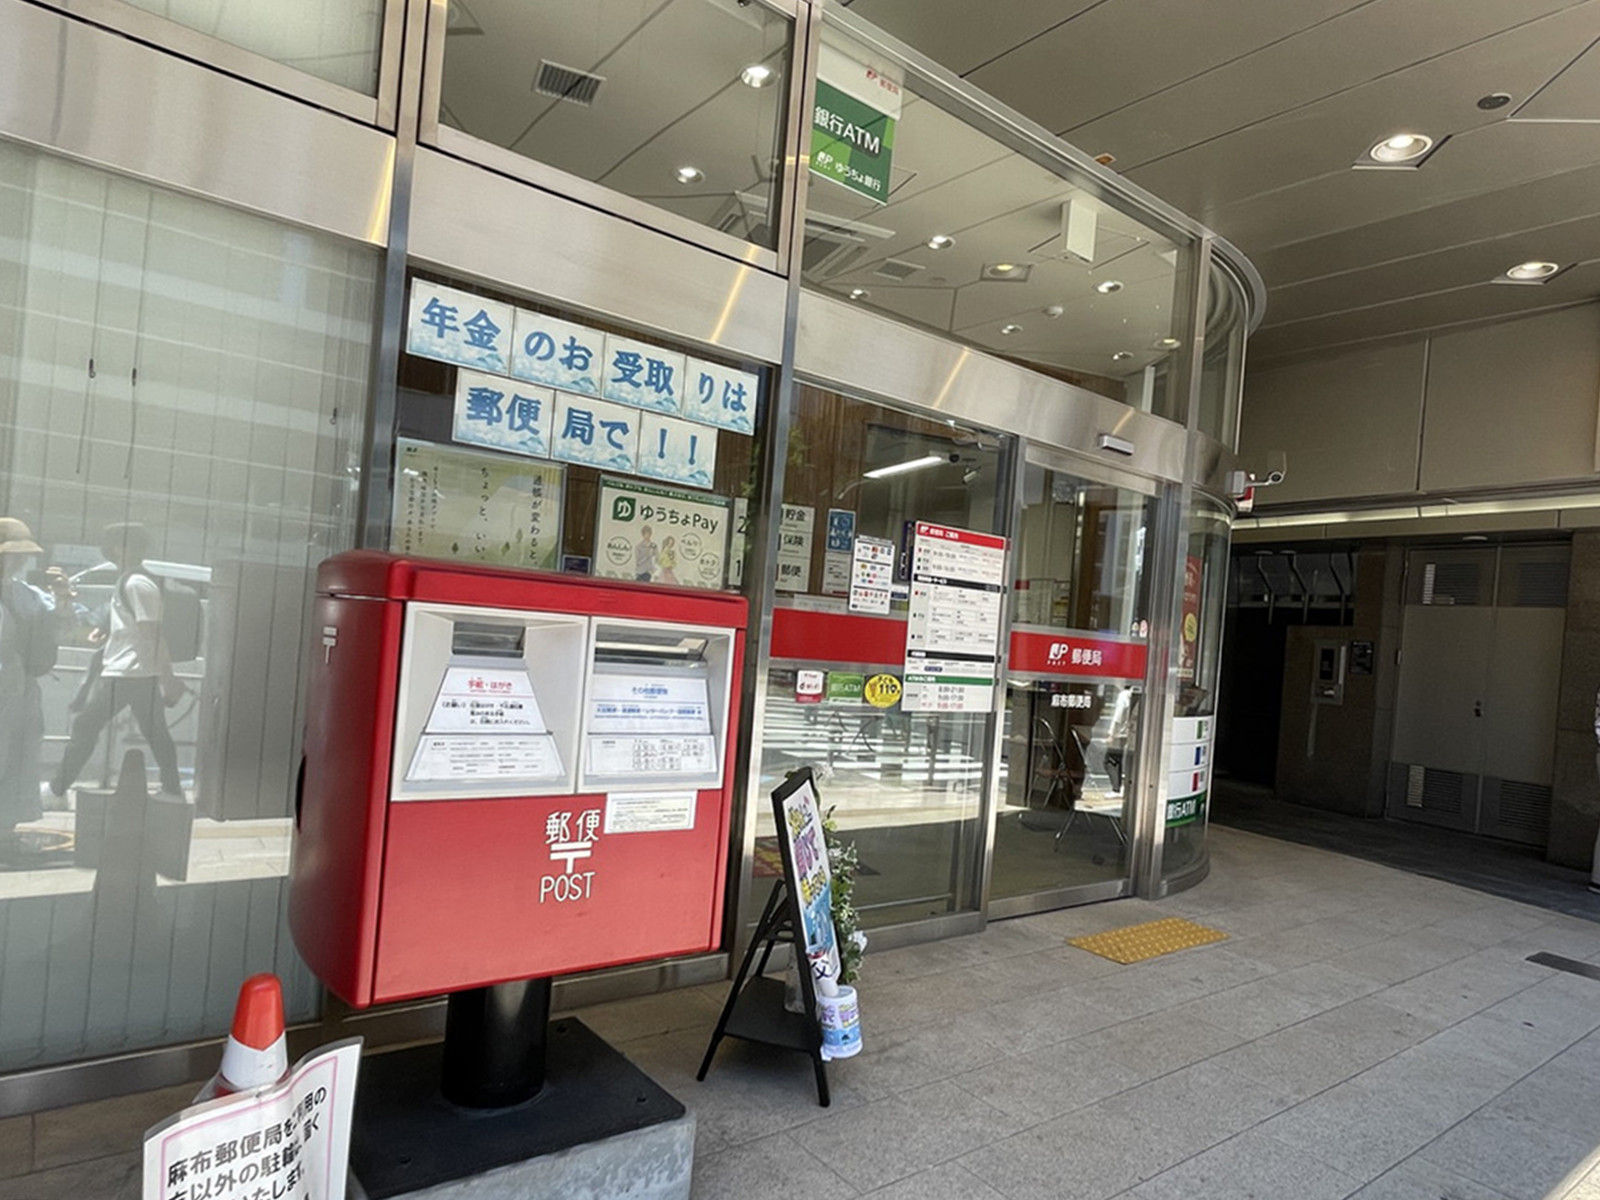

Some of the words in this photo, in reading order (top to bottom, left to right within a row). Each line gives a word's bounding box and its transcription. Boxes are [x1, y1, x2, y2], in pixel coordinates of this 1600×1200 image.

[814, 106, 880, 154] 銀行ATM
[834, 162, 881, 191] ゆうちょ銀行
[640, 504, 719, 534] ゆうちょPay
[1071, 648, 1102, 665] 郵便局
[545, 809, 601, 844] 郵便
[540, 872, 596, 904] POST
